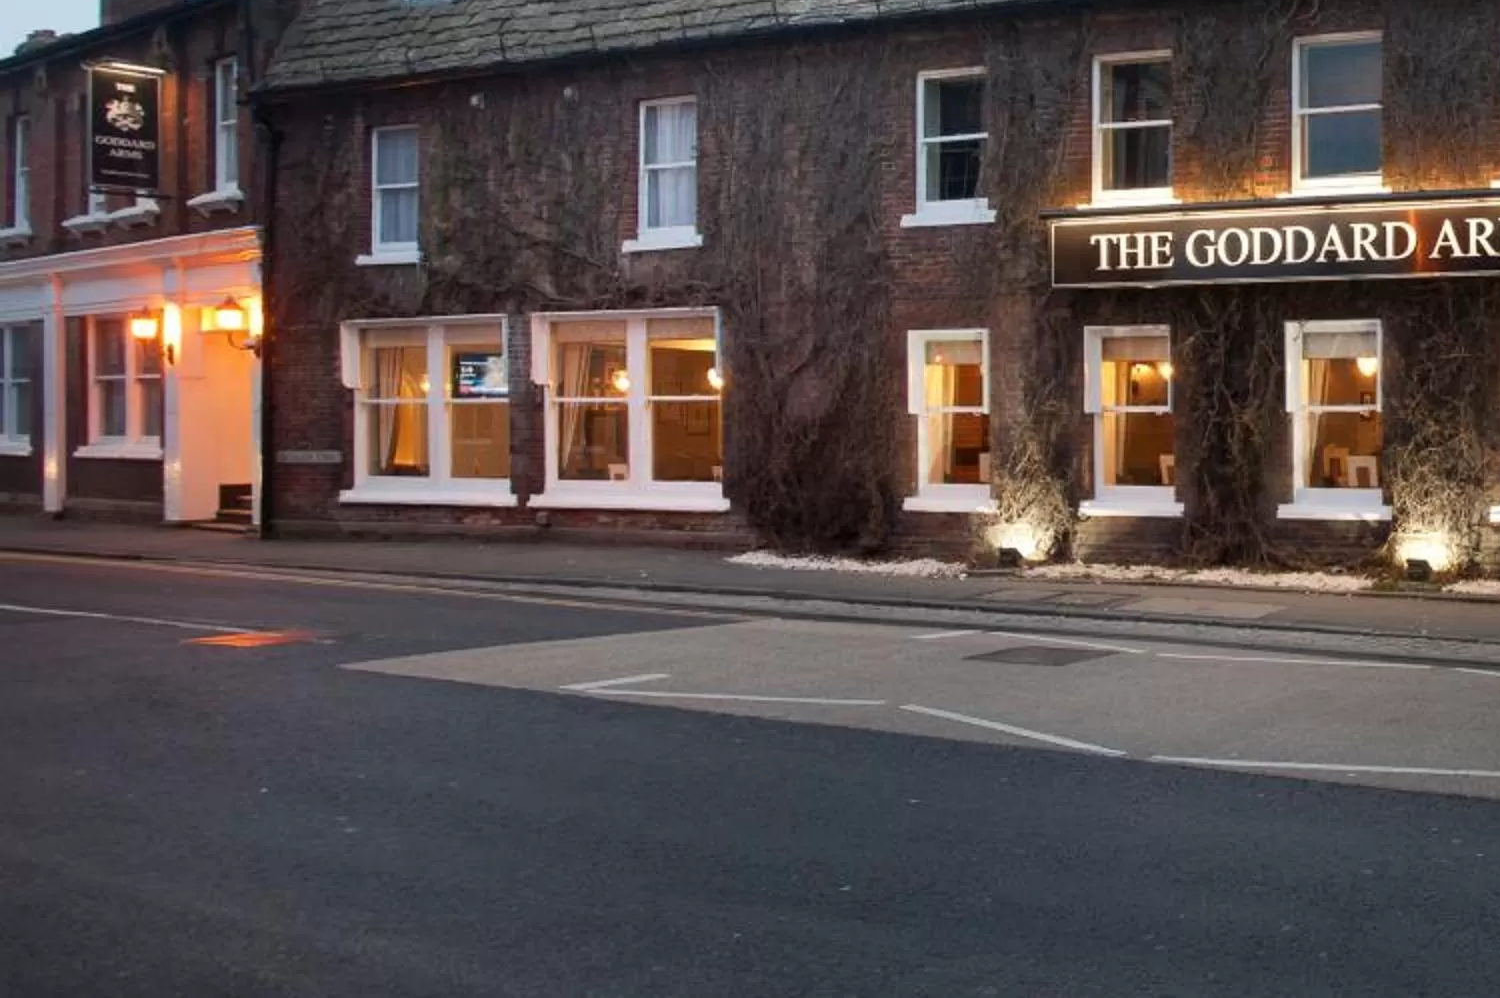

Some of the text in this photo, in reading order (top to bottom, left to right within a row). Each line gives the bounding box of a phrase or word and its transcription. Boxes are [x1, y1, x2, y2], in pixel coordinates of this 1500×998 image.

[95, 135, 155, 150] GODDARD
[1090, 231, 1175, 271] THE
[1185, 221, 1418, 268] GODDARD
